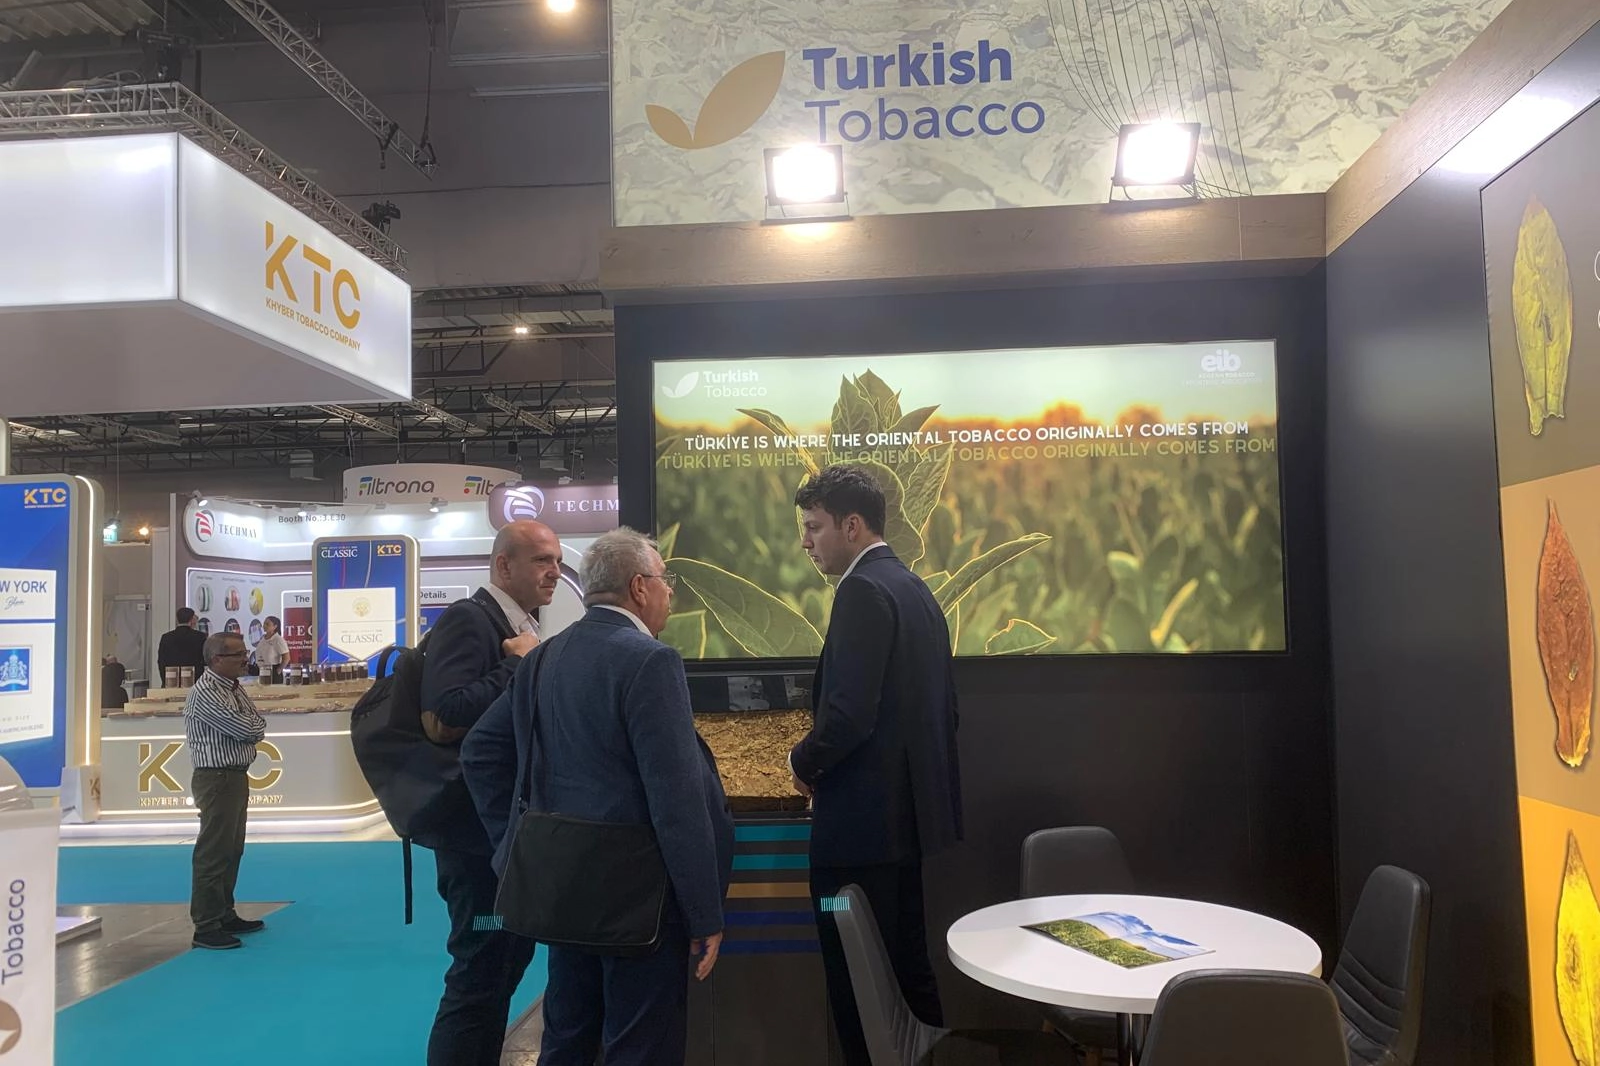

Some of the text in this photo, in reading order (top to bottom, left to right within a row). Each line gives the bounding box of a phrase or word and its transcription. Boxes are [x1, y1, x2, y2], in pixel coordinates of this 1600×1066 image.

[802, 39, 1012, 91] Turkish
[804, 98, 1045, 143] Tobacco
[265, 220, 361, 330] KTC
[265, 297, 361, 351] KHYBER TOBACCO COMPANY
[1201, 348, 1241, 372] eib
[703, 369, 758, 383] Turkish
[704, 385, 767, 398] Tobacco
[685, 421, 1249, 450] TÜRKİYE IS WHERE THE ORIENTAL TOBACCO ORIGINALLY COMES FROM
[662, 452, 731, 469] TÜRKİYE
[736, 453, 751, 467] IS
[949, 445, 1038, 462] TOBACCO
[1043, 442, 1150, 459] ORIGINALLY
[1157, 439, 1219, 455] COMES
[1225, 438, 1275, 453] FROM
[359, 476, 434, 496] Filtrona
[24, 488, 67, 504] KTC
[554, 499, 619, 512] TECHM
[278, 514, 303, 523] Booth
[321, 549, 358, 558] CLASSIC
[377, 544, 402, 554] KTC
[13, 580, 47, 593] YORK
[294, 595, 310, 603] The
[341, 633, 383, 644] CLASSIC
[138, 740, 283, 793] KC
[140, 796, 179, 807] KHYBER
[248, 794, 283, 805] MPANY
[1, 879, 25, 985] Tobacco
